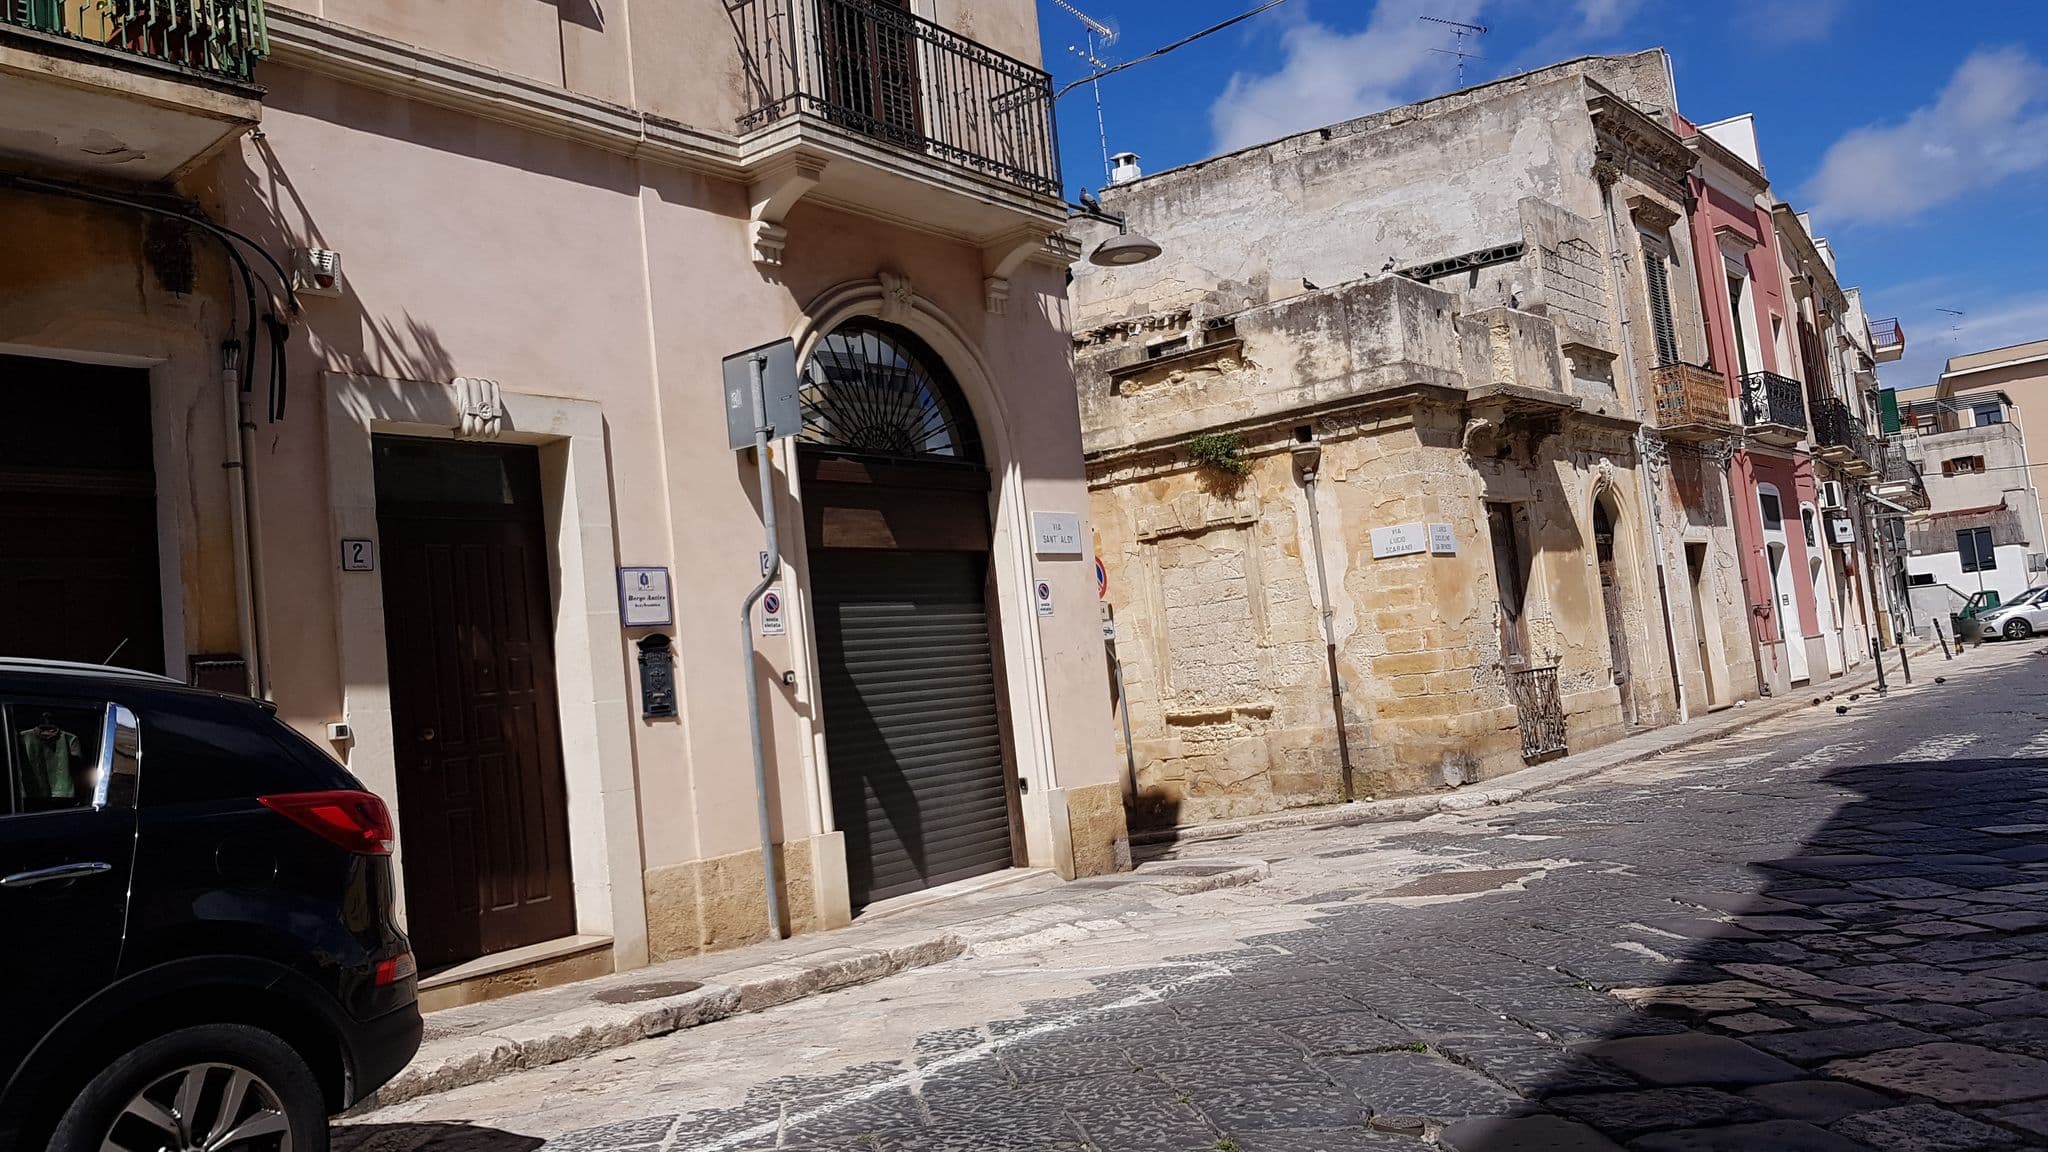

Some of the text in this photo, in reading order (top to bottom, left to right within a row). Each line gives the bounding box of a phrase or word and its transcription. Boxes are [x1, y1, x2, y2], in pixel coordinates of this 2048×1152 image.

[1052, 523, 1062, 531] VIA
[1389, 536, 1406, 545] LUCIO
[353, 543, 363, 563] 2
[1385, 544, 1413, 554] SCARANO
